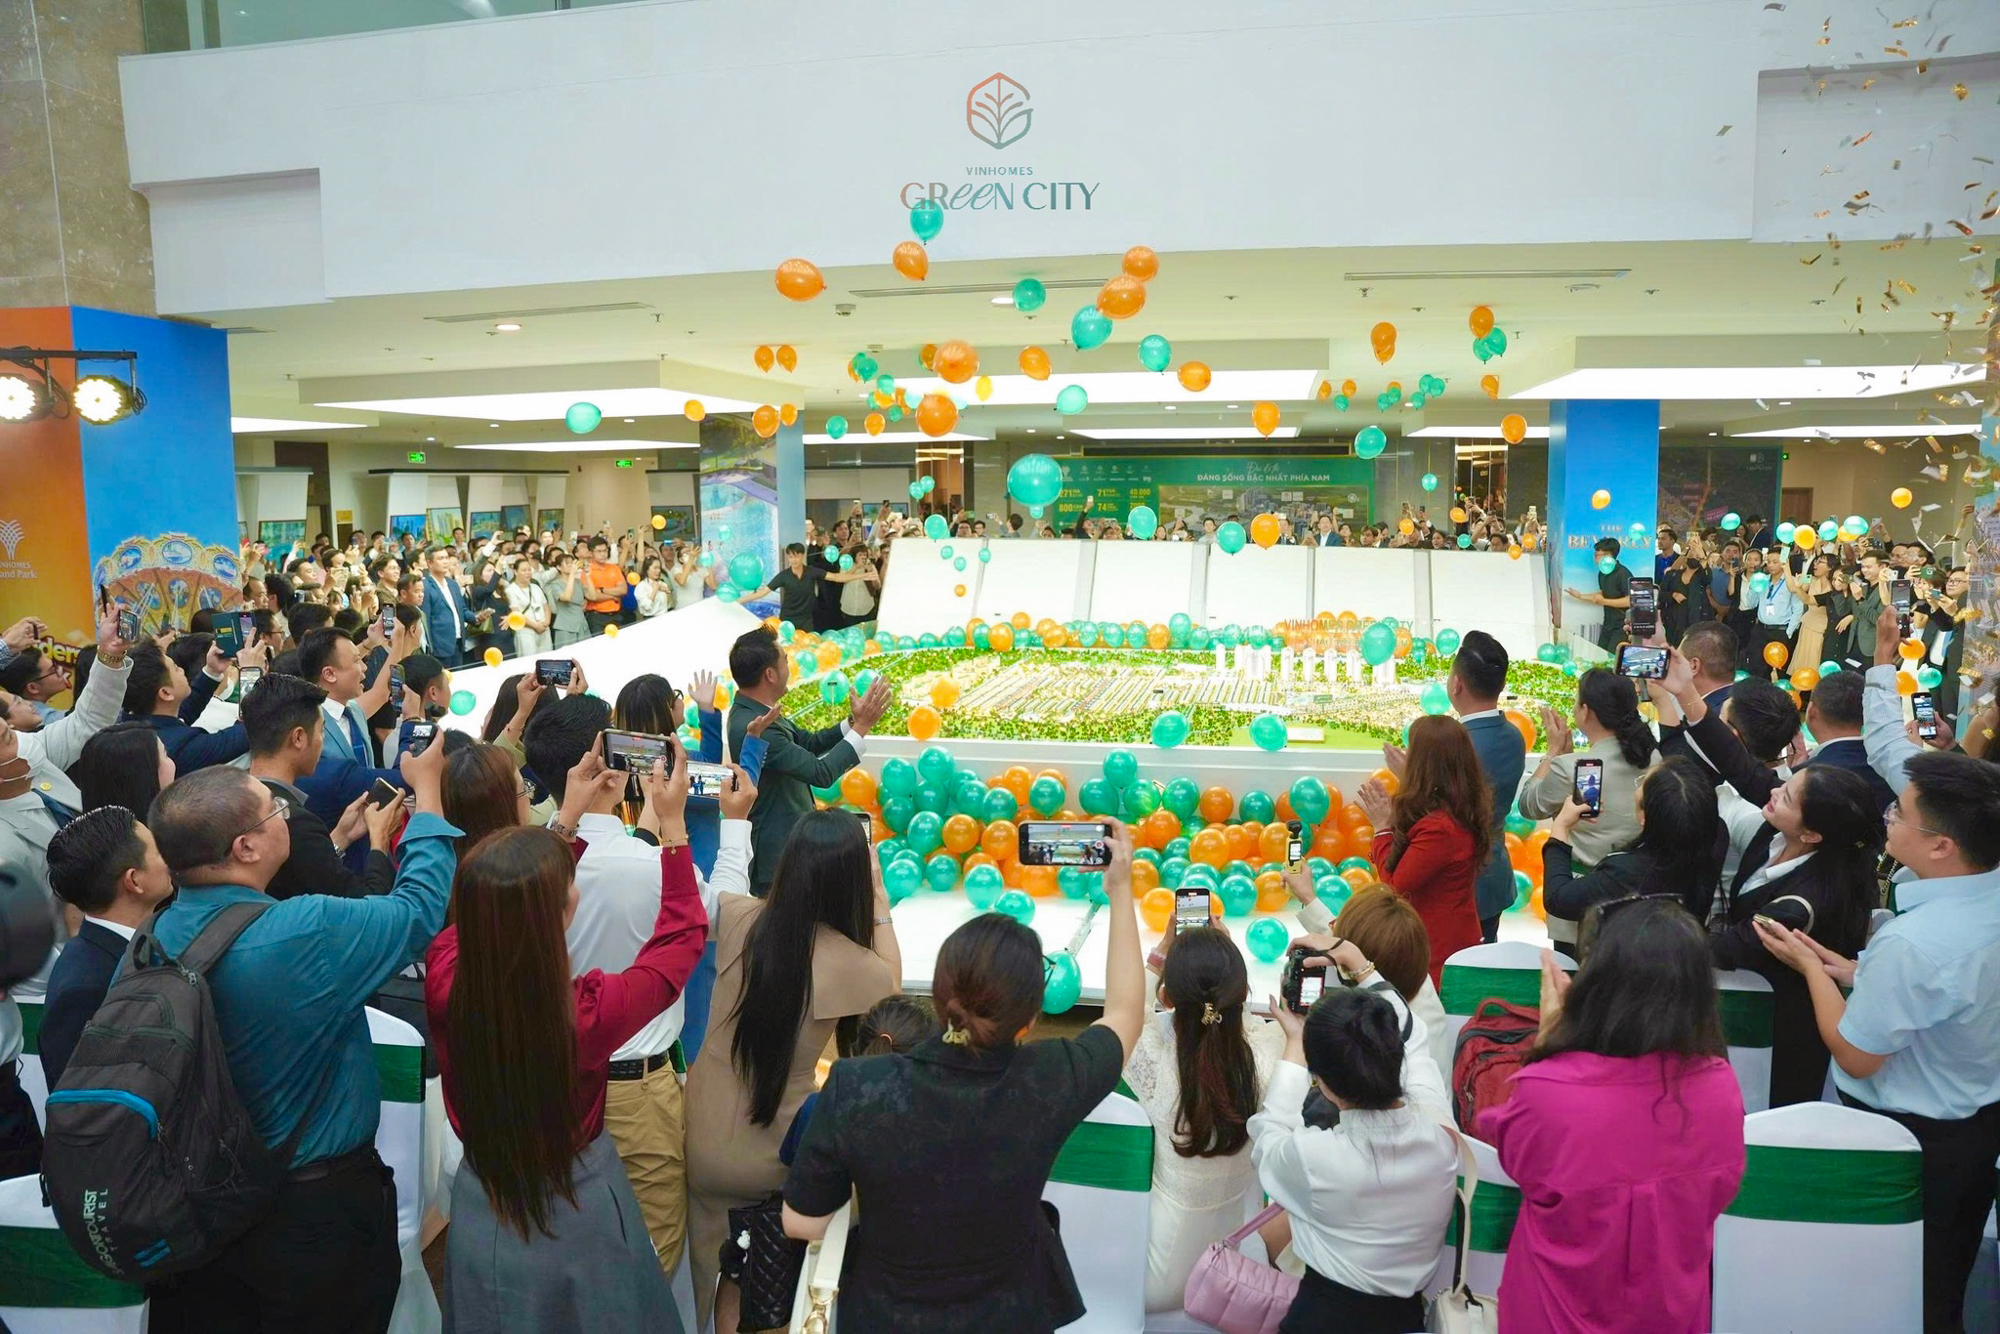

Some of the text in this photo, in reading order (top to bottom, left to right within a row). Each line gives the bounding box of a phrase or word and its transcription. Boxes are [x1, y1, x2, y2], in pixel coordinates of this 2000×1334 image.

[966, 166, 1034, 176] VINHOMES
[1022, 182, 1101, 210] CITY
[1290, 473, 1309, 482] PHÍA
[1311, 474, 1330, 482] NAM
[1568, 534, 1654, 549] BEVRLY
